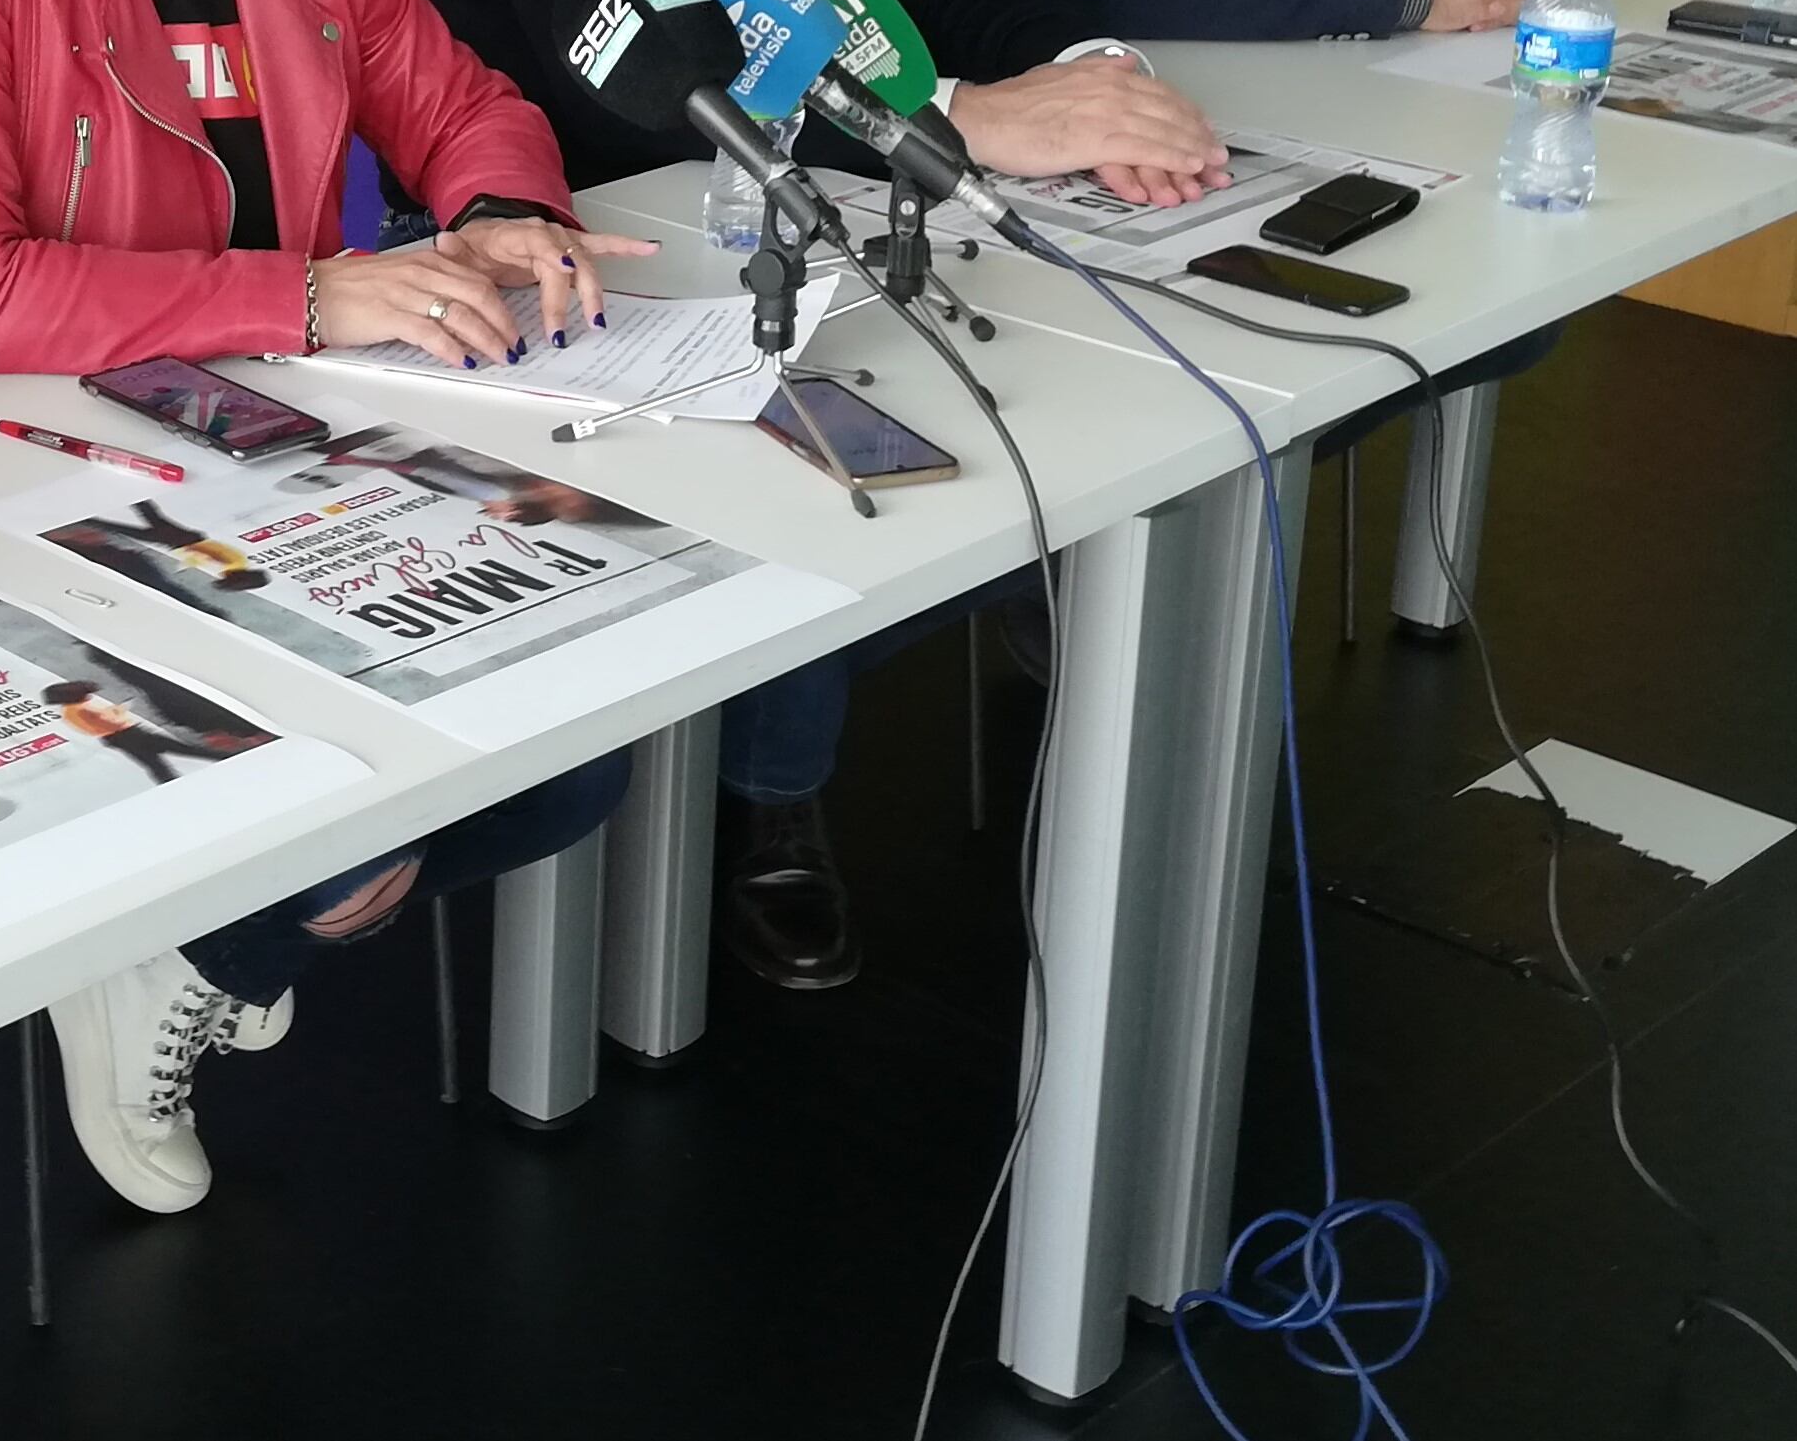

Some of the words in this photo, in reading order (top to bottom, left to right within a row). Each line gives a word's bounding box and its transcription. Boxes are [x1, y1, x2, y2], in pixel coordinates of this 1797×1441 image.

[733, 24, 792, 95] televisió
[345, 517, 371, 530] LES
[369, 511, 387, 521] A
[385, 508, 402, 518] FI
[247, 526, 352, 564] DESIGUALTATS
[317, 529, 387, 558] CONTENIR
[350, 539, 405, 562] APUJAR
[458, 524, 541, 559] la
[270, 552, 322, 573] PREUS
[291, 559, 355, 583] SALARIS
[347, 559, 556, 640] MAIG
